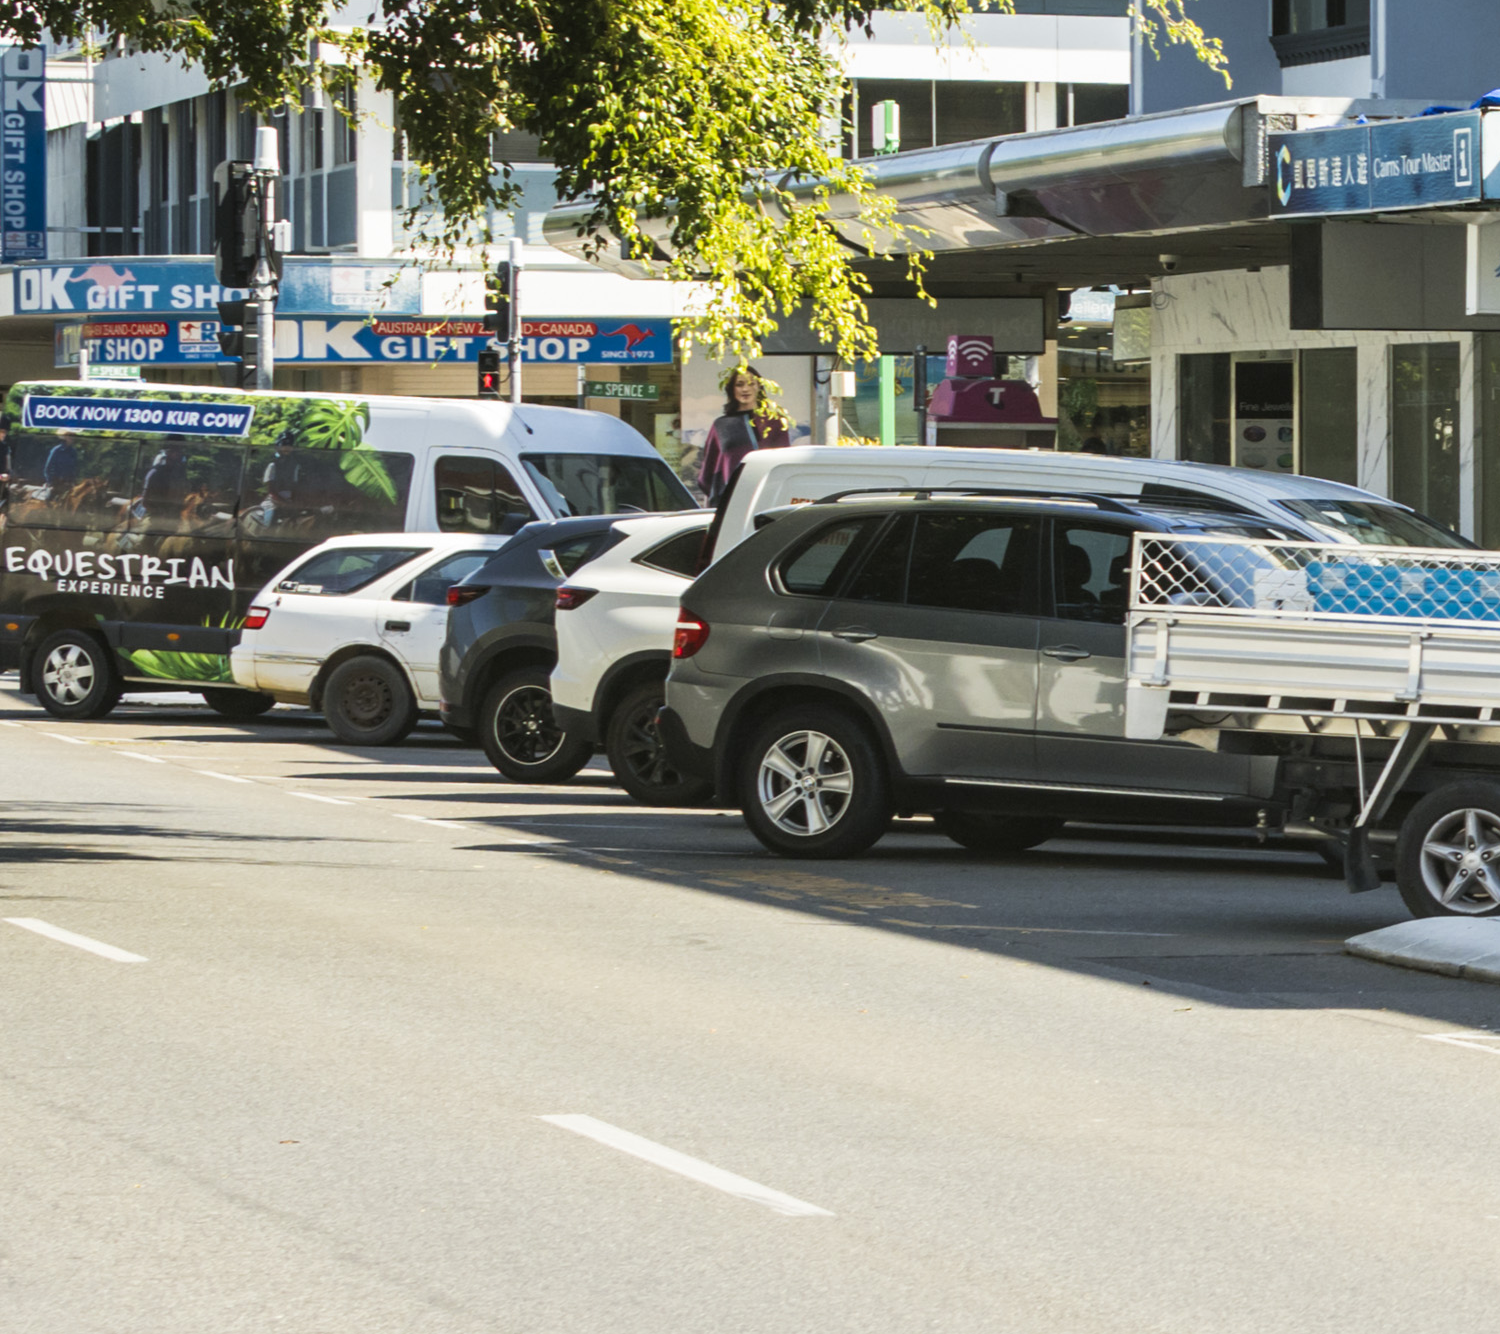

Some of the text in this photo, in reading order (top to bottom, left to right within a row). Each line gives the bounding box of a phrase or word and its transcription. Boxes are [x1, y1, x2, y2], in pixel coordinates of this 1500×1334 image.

[4, 113, 26, 229] GIFT SHOP
[1373, 154, 1398, 180] Cairns
[1400, 153, 1421, 177] Tour
[1421, 151, 1453, 175] Master
[19, 267, 250, 311] OK GIFT SHO
[105, 338, 164, 361] SHOP
[380, 337, 591, 360] GIFT SHOP
[601, 350, 655, 359] SINCE 1973
[605, 383, 644, 398] SPENCE
[34, 404, 245, 429] BOOK NOW 1300 KUR COW
[5, 546, 236, 591] EQUESTRIAN
[56, 579, 165, 599] EXPERIENCE
